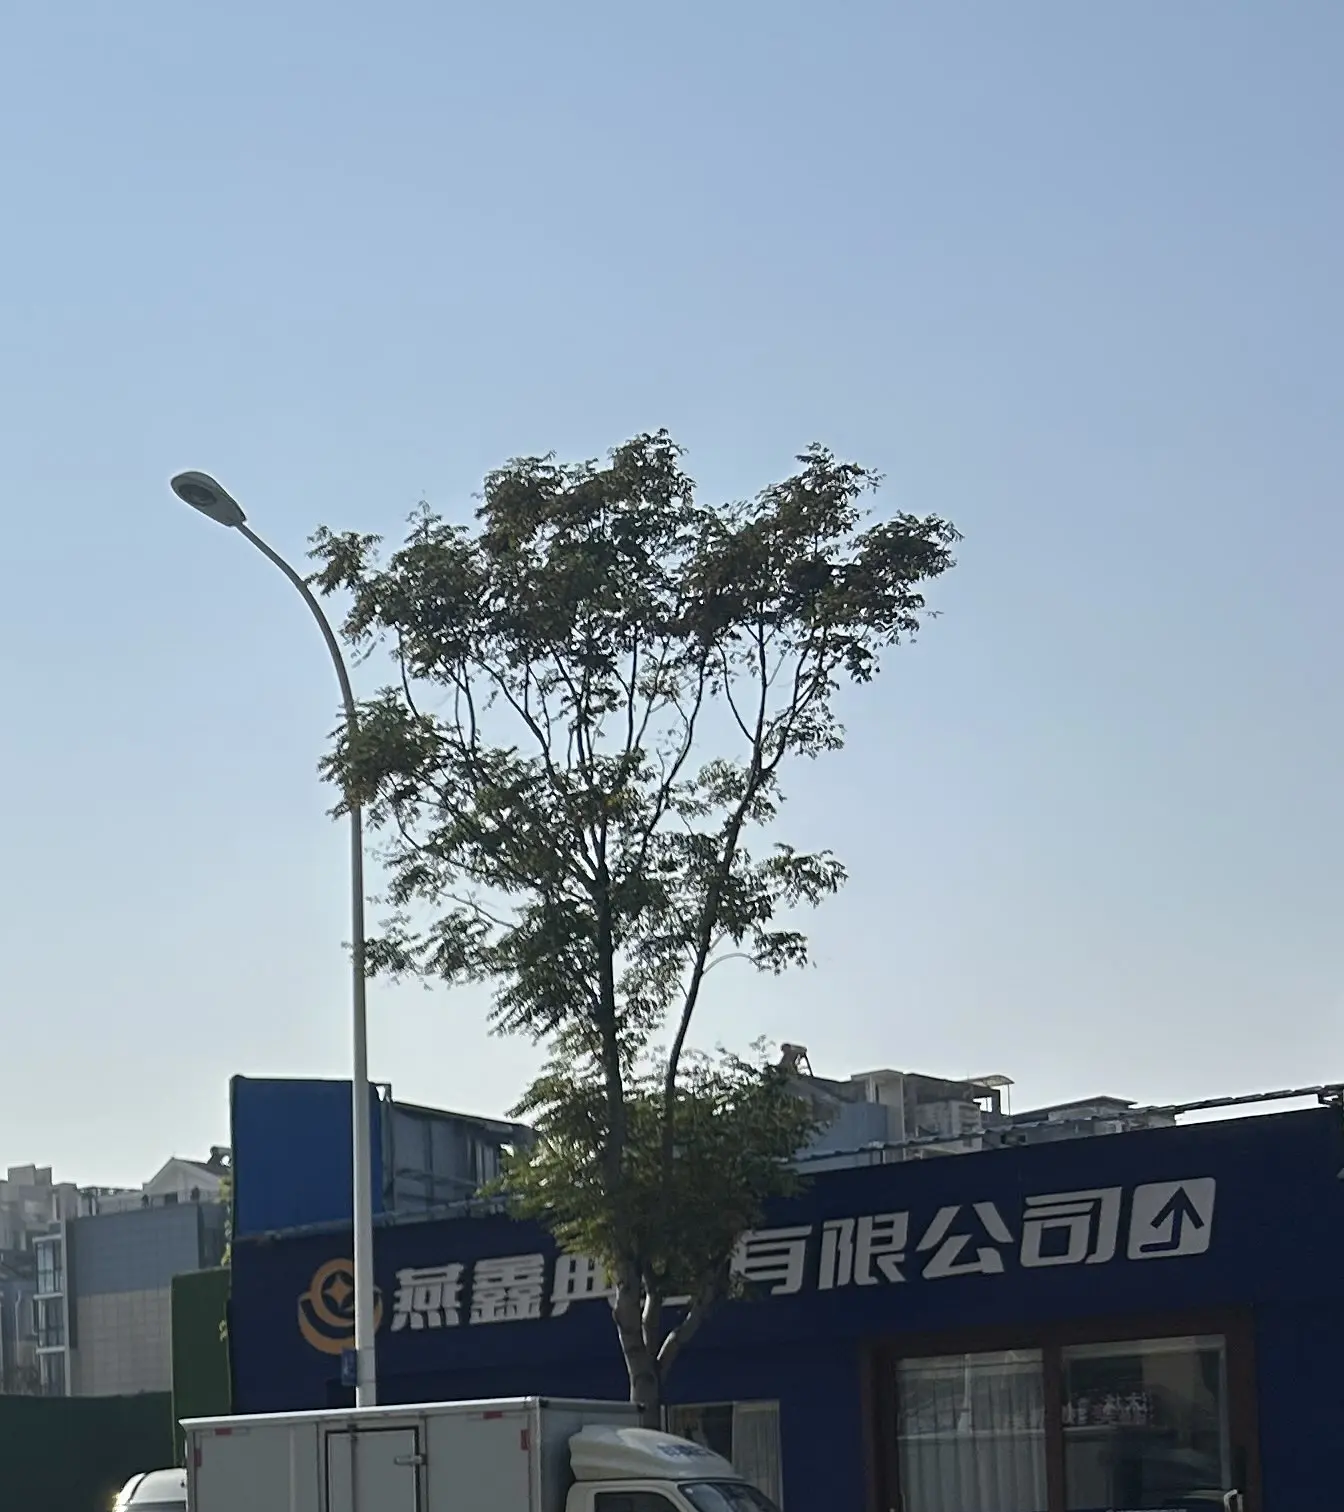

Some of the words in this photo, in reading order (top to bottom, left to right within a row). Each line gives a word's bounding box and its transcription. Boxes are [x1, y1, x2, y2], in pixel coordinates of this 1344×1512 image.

[391, 1186, 1122, 1333] 燕鑫典有限公司
